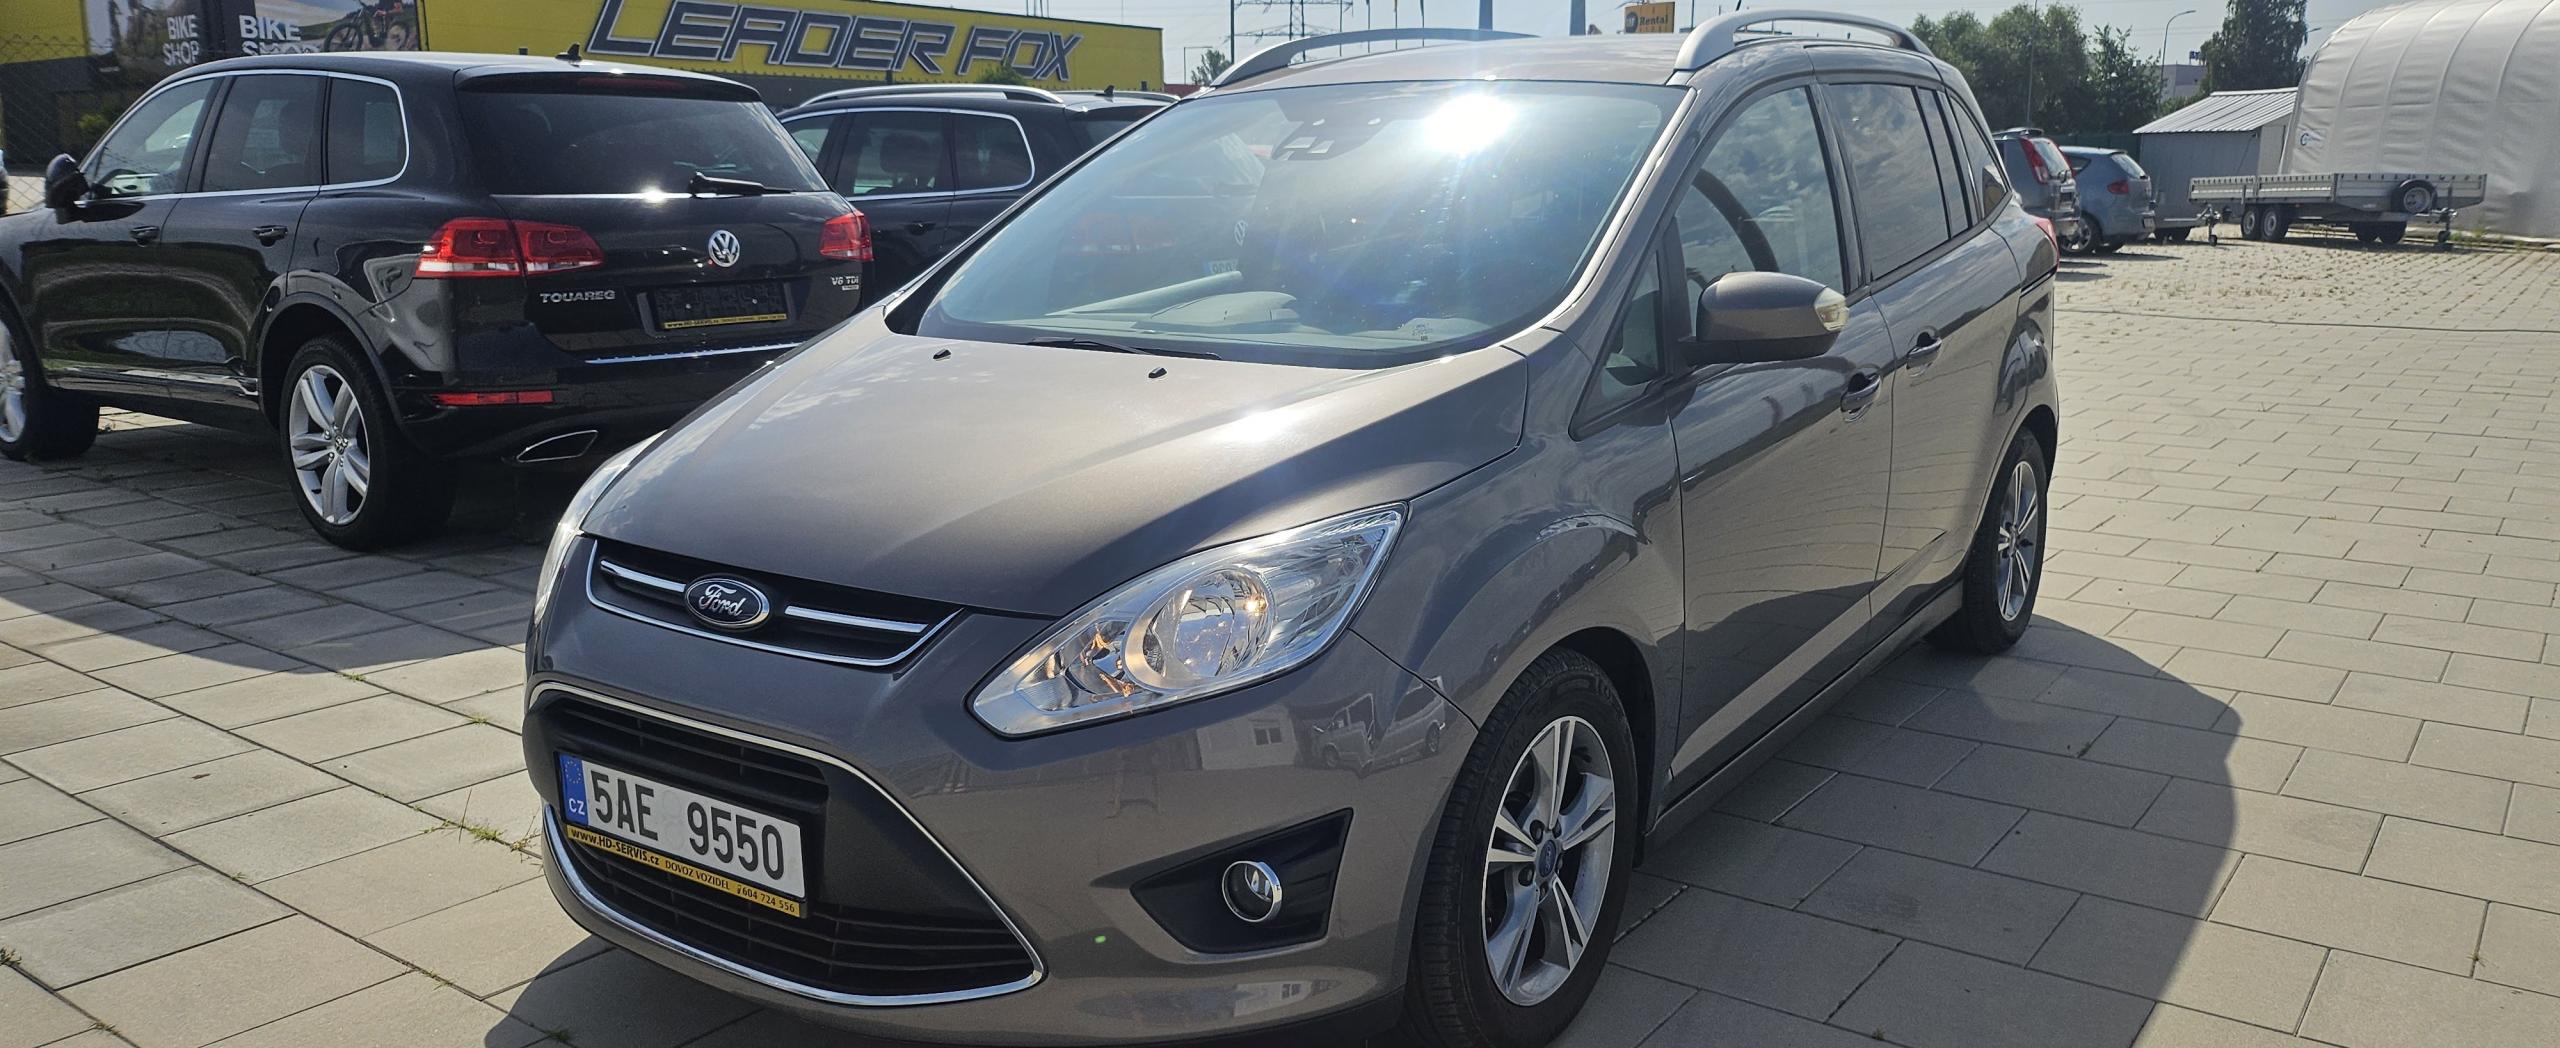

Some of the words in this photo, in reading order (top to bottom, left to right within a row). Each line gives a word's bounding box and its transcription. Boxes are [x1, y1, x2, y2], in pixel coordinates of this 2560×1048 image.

[167, 14, 199, 40] BIKE
[238, 14, 301, 41] BIKE
[587, 0, 958, 75] LEADER
[956, 25, 1083, 81] FOX
[162, 40, 200, 66] SHOP
[540, 289, 616, 303] TOUAREG
[698, 584, 747, 616] Ford
[568, 797, 586, 816] CZ
[590, 769, 659, 842] 5AE
[686, 801, 785, 881] 9550
[570, 827, 660, 865] www.HD-SERVIS.cz
[665, 859, 695, 877] DOVOZ
[696, 869, 731, 890] VOZIDEL
[742, 886, 759, 901] 604
[760, 893, 777, 906] 724
[779, 899, 796, 913] 556
